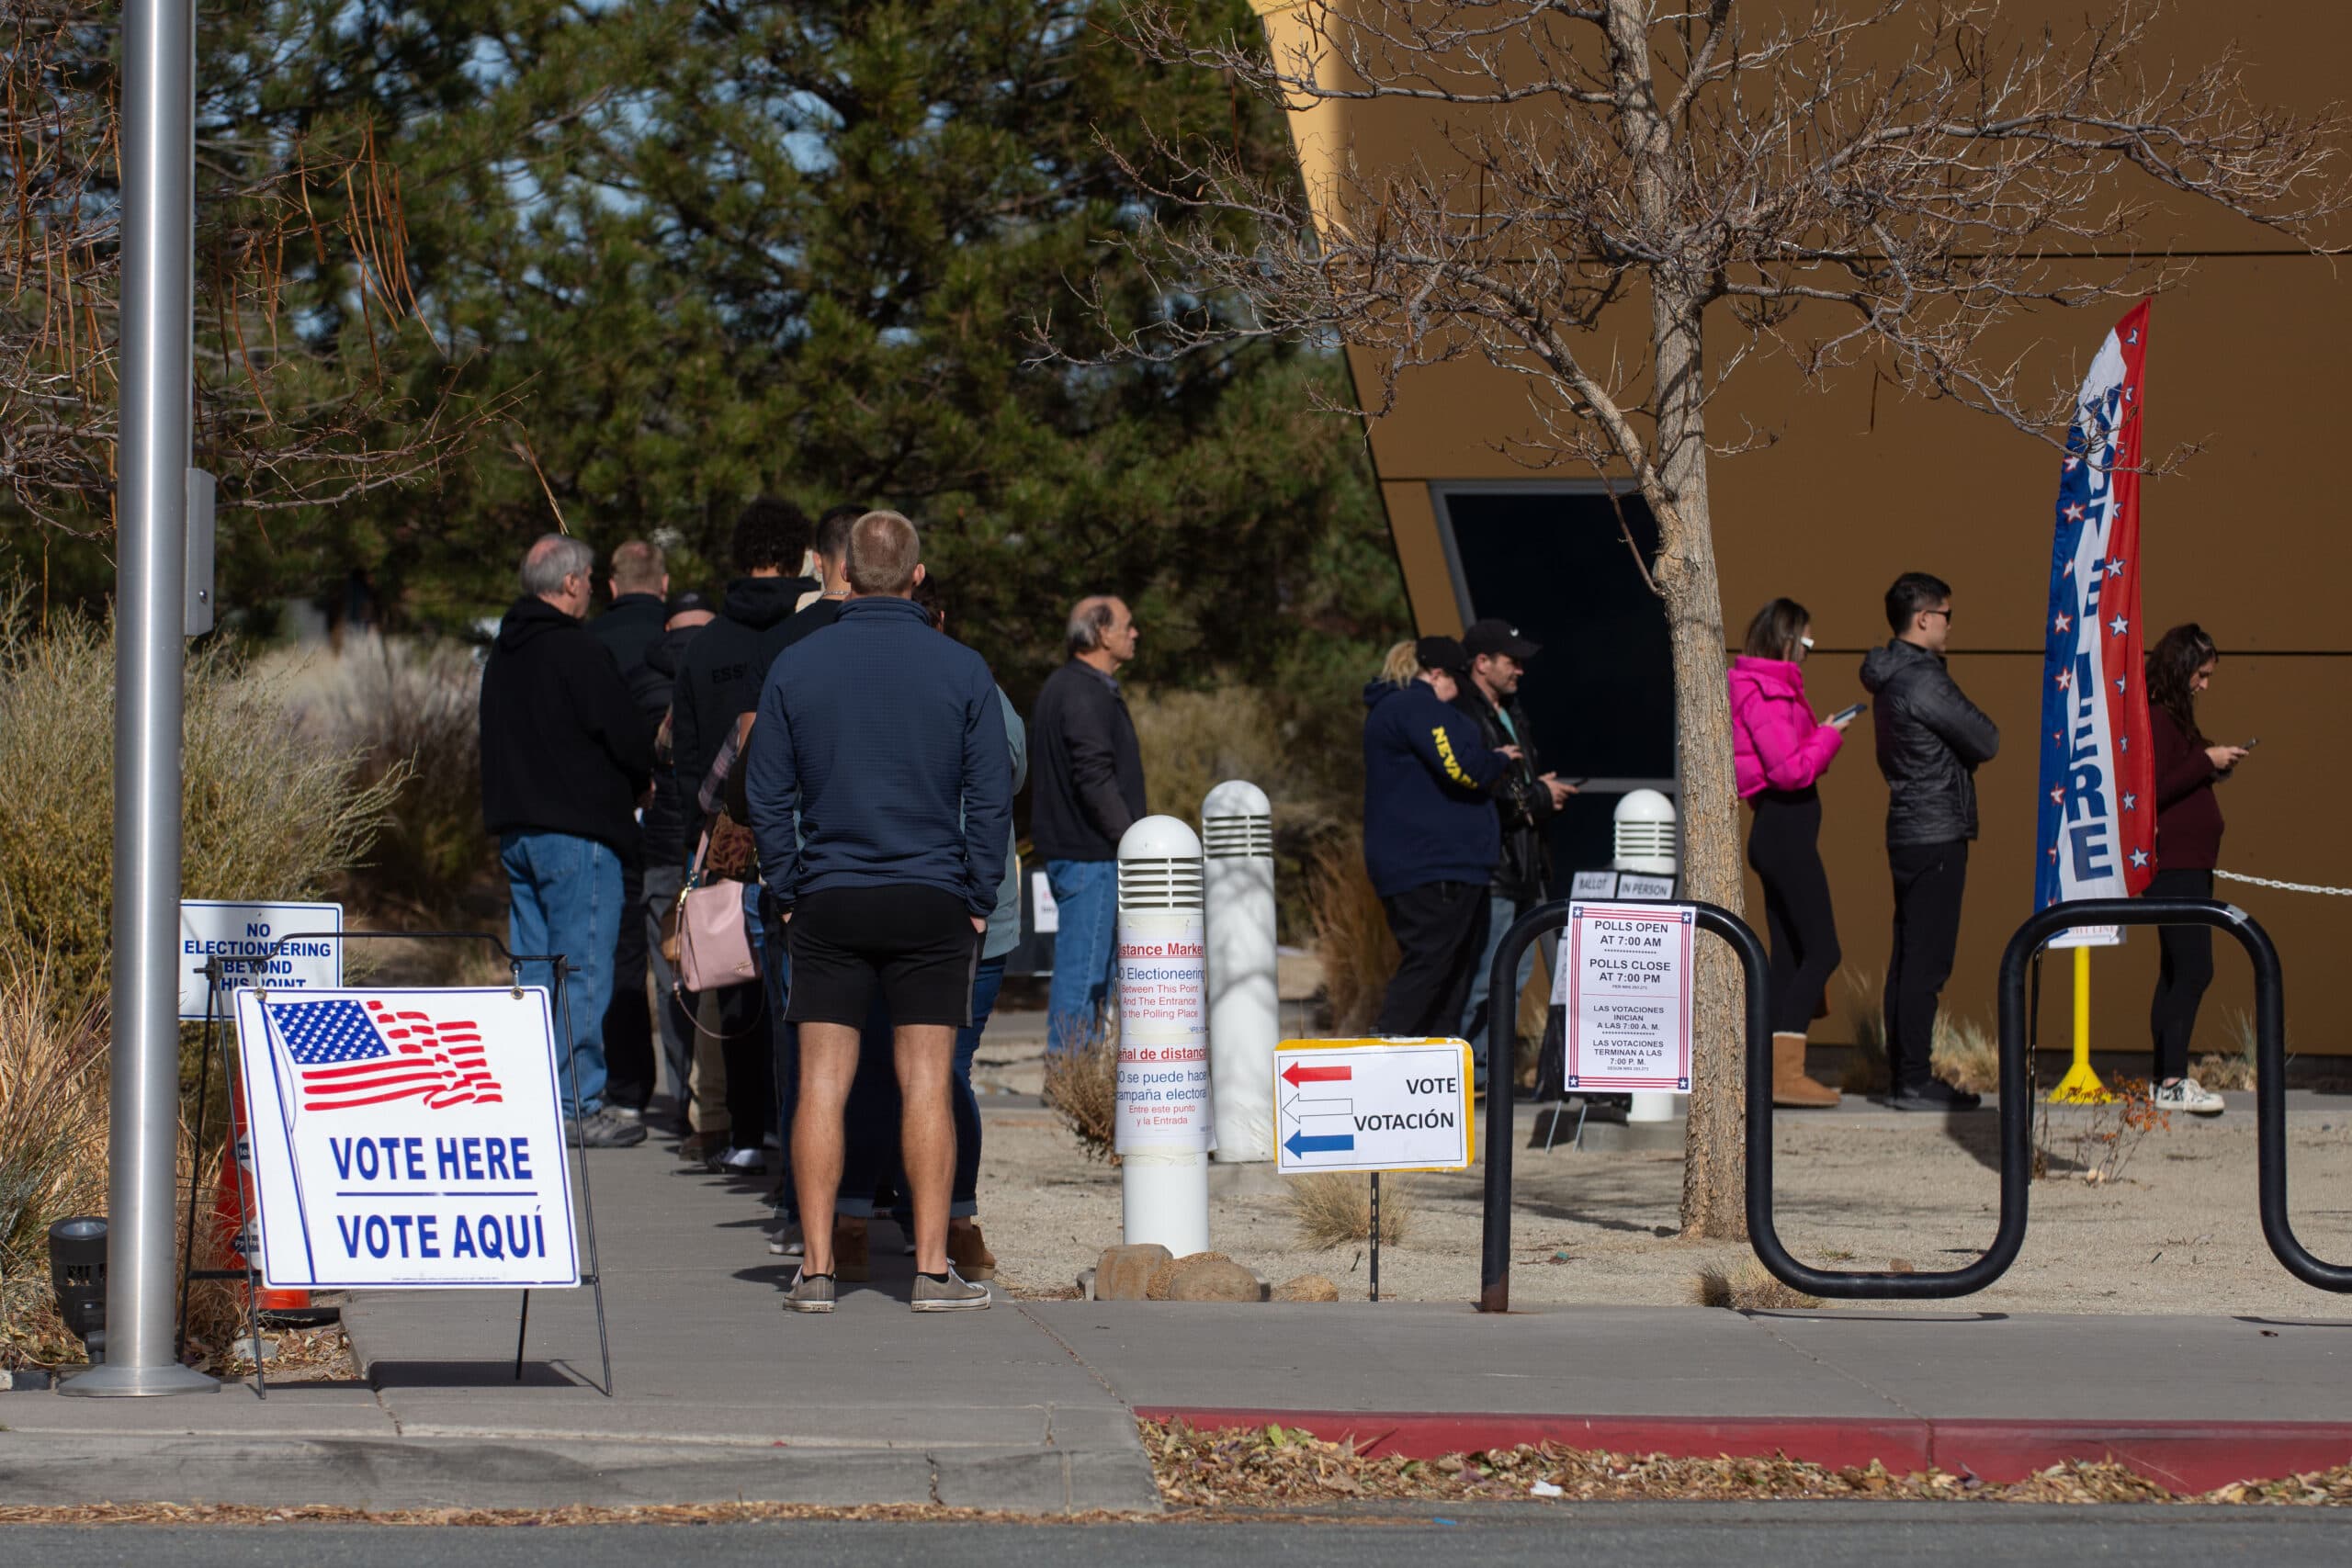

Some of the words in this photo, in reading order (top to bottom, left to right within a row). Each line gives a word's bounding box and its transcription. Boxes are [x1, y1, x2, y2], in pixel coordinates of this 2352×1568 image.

[1622, 883, 1630, 892] IN
[1632, 884, 1668, 895] PERSON
[246, 923, 270, 937] NO
[1594, 920, 1633, 931] POLLS
[1636, 922, 1668, 933] OPEN
[1600, 935, 1614, 944] AT
[1618, 936, 1641, 946] 7:00
[1644, 937, 1661, 947] AM
[1589, 958, 1628, 969] POLLS
[1631, 961, 1671, 971] CLOSE
[1599, 973, 1613, 981] AT
[1617, 974, 1640, 983] 7:00
[1644, 975, 1660, 984] PM
[1122, 984, 1154, 993] Between
[1181, 985, 1198, 993] Point
[1124, 997, 1136, 1005] And
[1139, 997, 1155, 1005] The
[1159, 997, 1196, 1005] Entrance
[1129, 1010, 1140, 1018] the
[1144, 1010, 1174, 1020] Polling
[1178, 1010, 1198, 1018] Place
[1140, 1047, 1156, 1059] de
[1127, 1073, 1139, 1083] se
[1143, 1071, 1183, 1085] puede
[1406, 1077, 1457, 1094] VOTE
[1128, 1105, 1148, 1113] Entre
[1173, 1104, 1196, 1114] punto
[1136, 1118, 1140, 1127] y
[1153, 1116, 1188, 1124] Entrada
[1353, 1109, 1453, 1131] VOTACIÓN
[330, 1137, 426, 1180] VOTE
[435, 1137, 533, 1180] HERE
[336, 1214, 441, 1259] VOTE
[453, 1205, 546, 1261] AQUÍ
